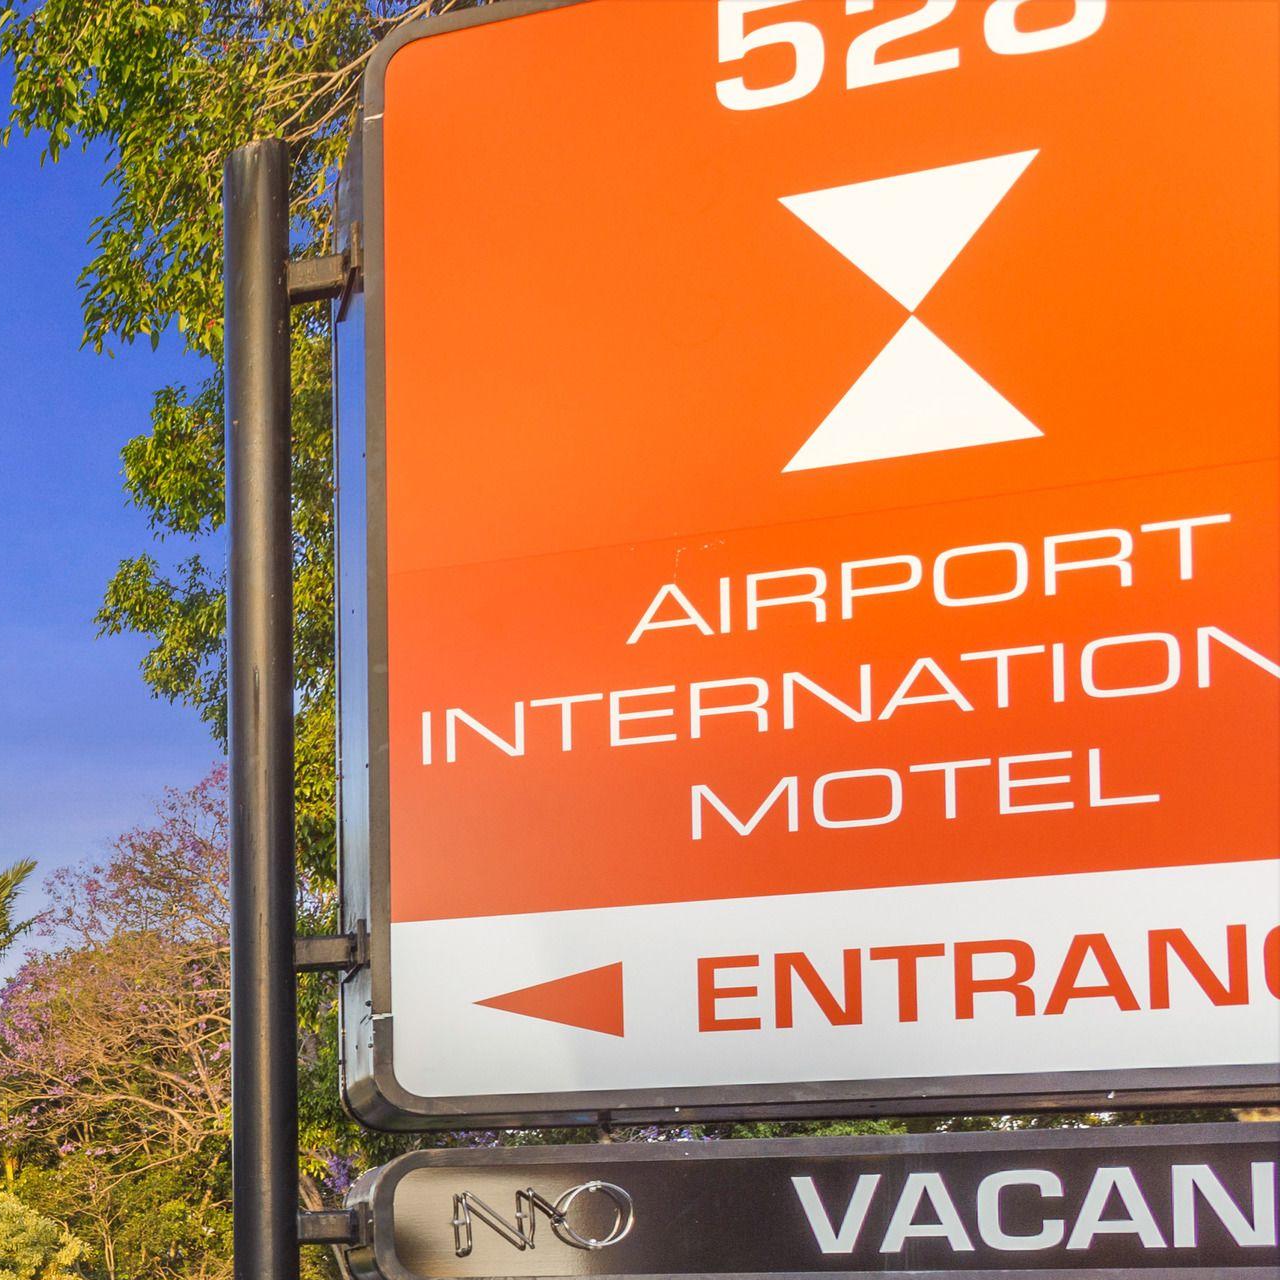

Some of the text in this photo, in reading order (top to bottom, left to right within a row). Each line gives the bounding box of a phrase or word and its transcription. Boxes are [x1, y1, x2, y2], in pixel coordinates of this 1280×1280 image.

[626, 513, 1232, 645] AIRPORT
[421, 625, 1280, 766] INTERNATION
[691, 748, 1161, 841] MOTEL
[697, 923, 1280, 1033] ENTRAN
[453, 1161, 1278, 1258] NO VACAN
